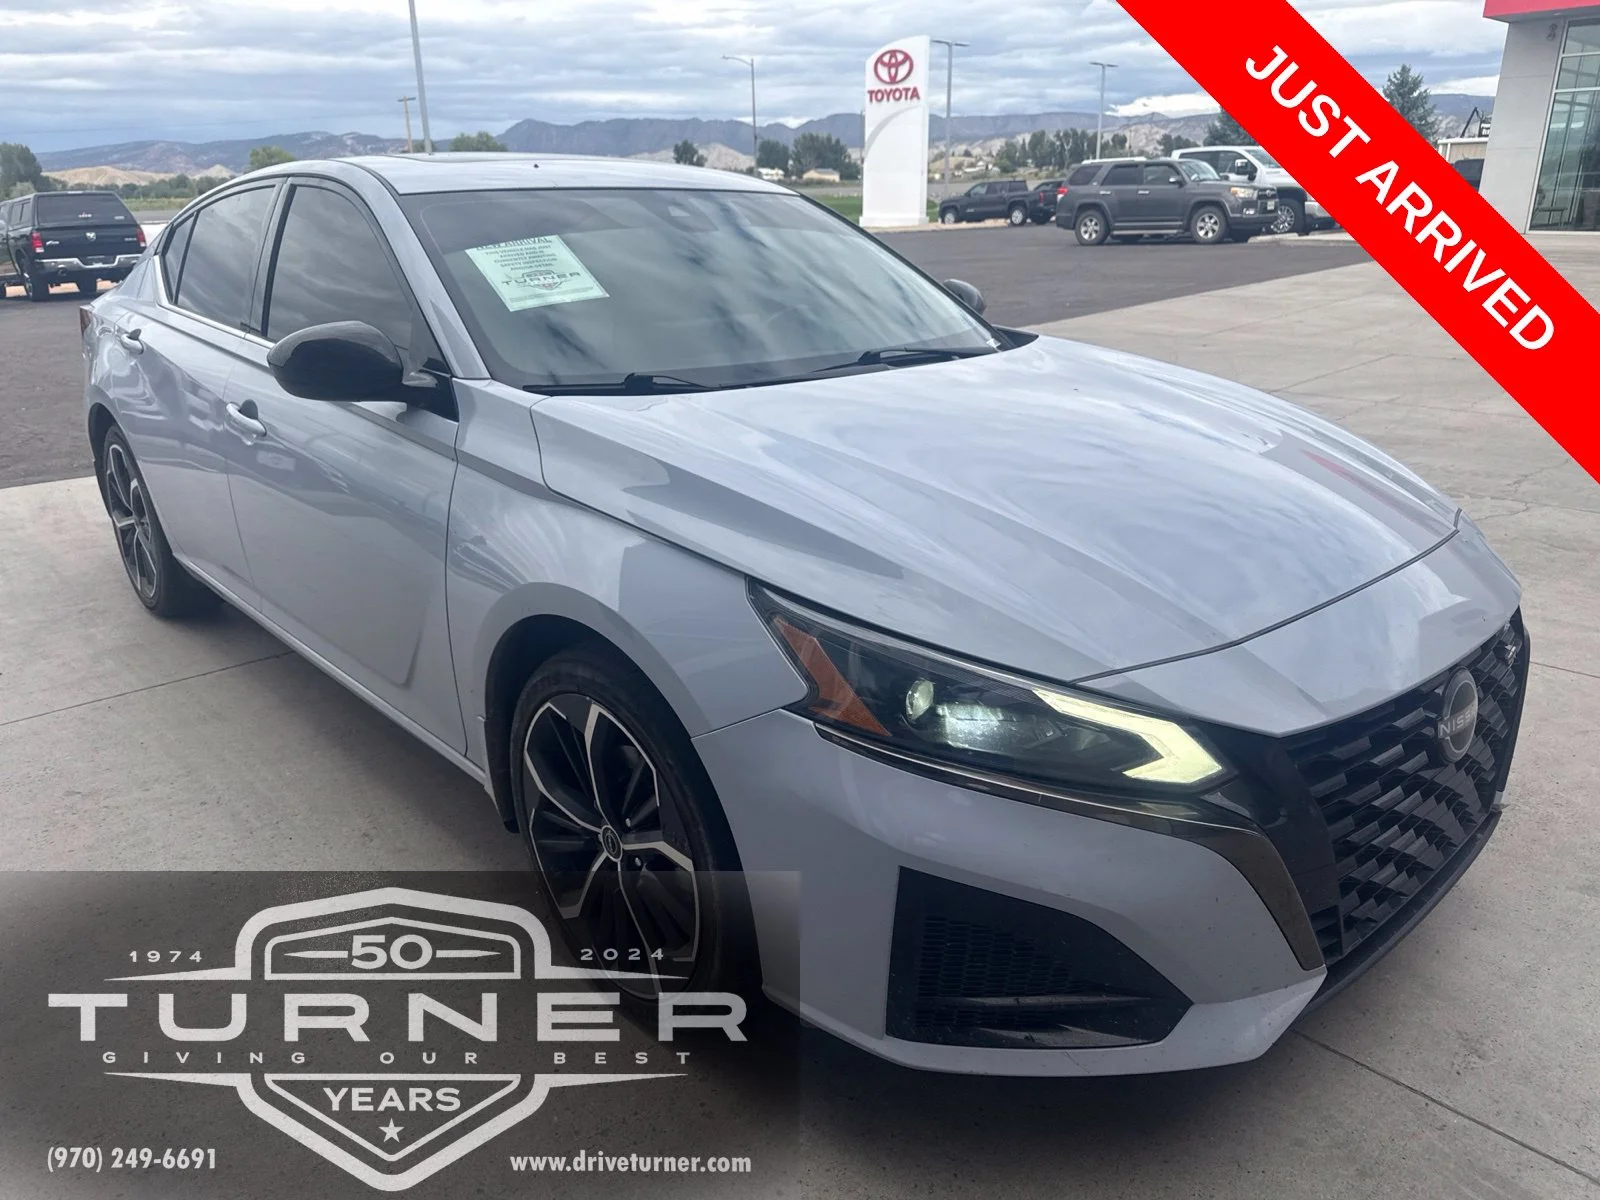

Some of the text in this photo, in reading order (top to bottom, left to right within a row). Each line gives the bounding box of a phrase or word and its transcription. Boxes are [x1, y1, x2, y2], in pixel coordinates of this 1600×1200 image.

[867, 87, 920, 103] TOYOTA
[501, 271, 581, 286] TURNER
[1440, 707, 1476, 736] NISS
